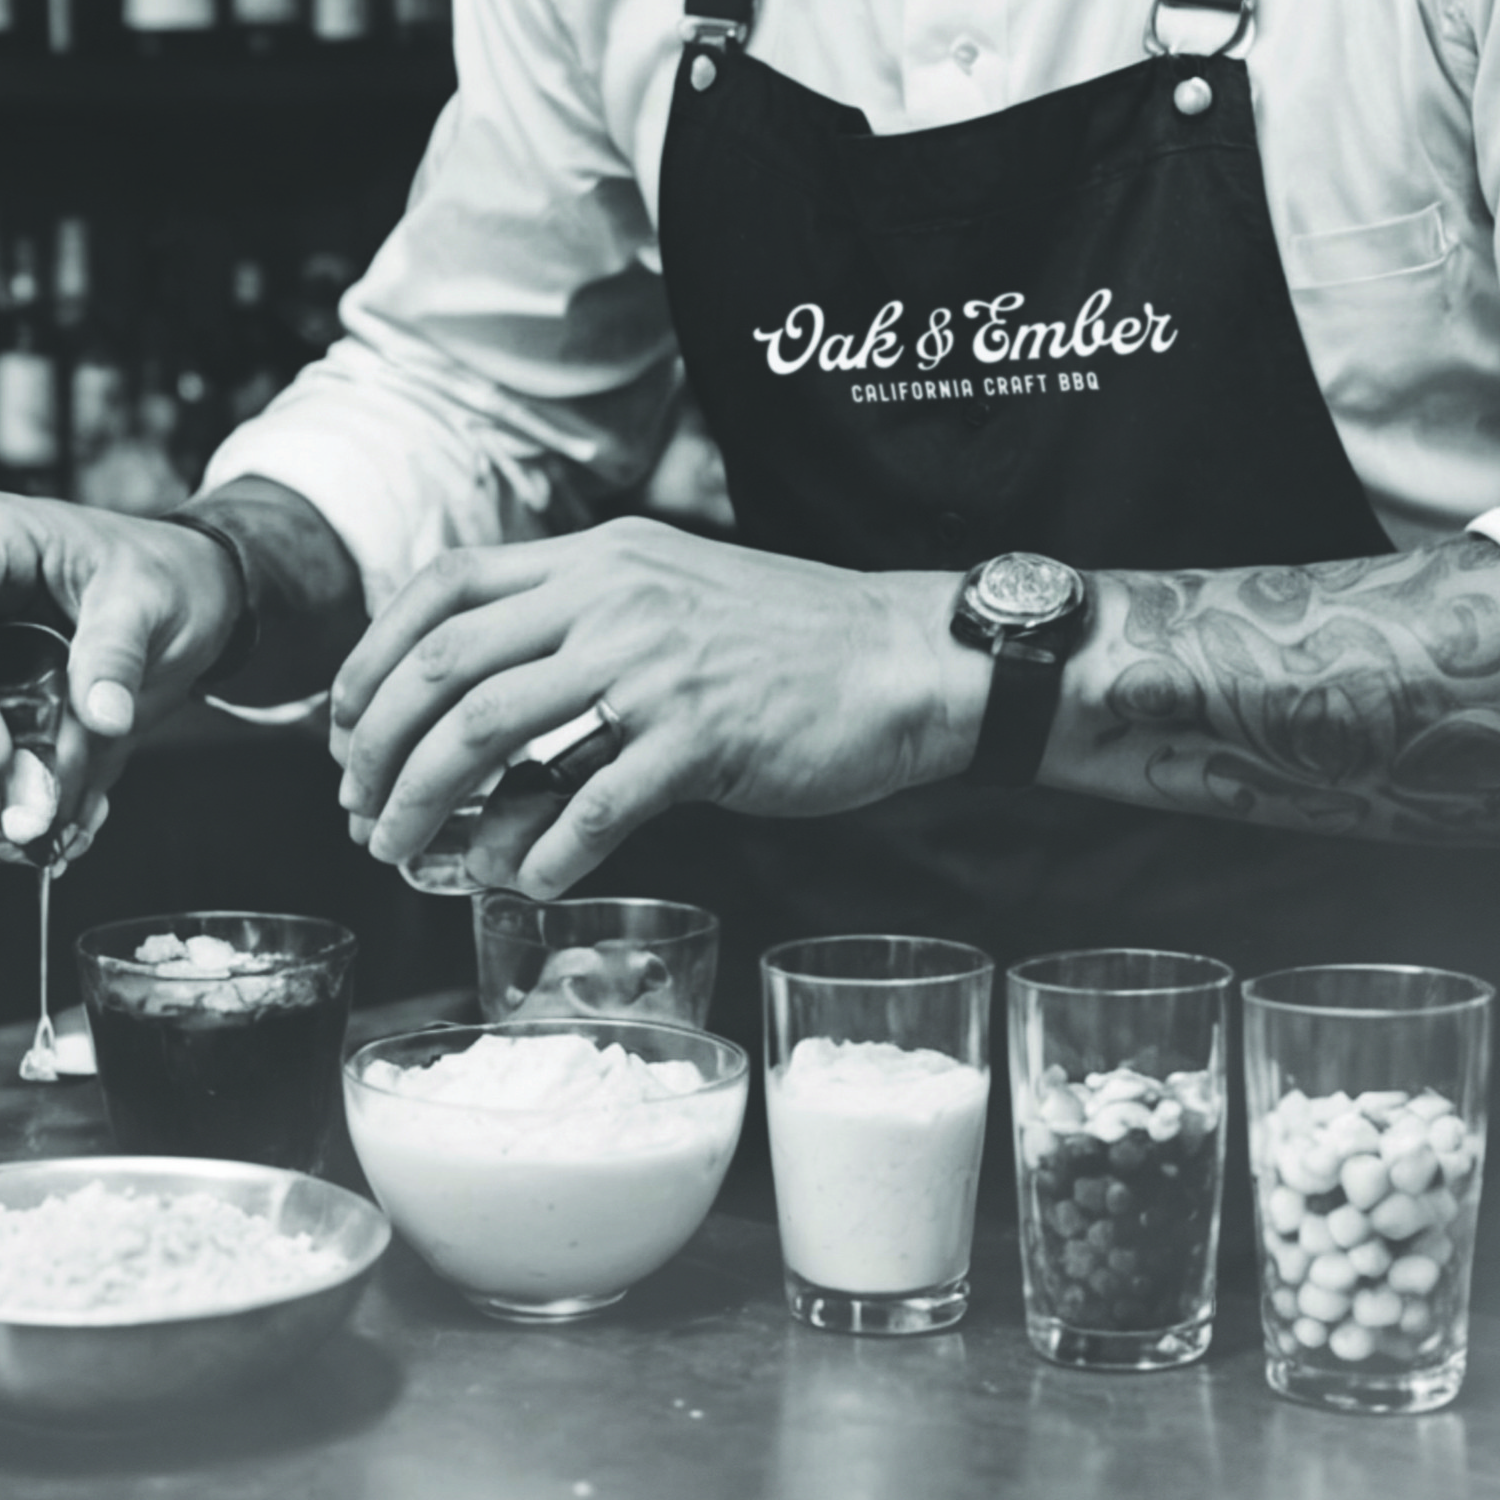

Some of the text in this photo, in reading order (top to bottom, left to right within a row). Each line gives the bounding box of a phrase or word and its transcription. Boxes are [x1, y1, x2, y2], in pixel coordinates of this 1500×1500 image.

[753, 288, 1178, 375] Oak & Ember
[851, 371, 1100, 403] CALIFORNIA CRAFT BBQ
